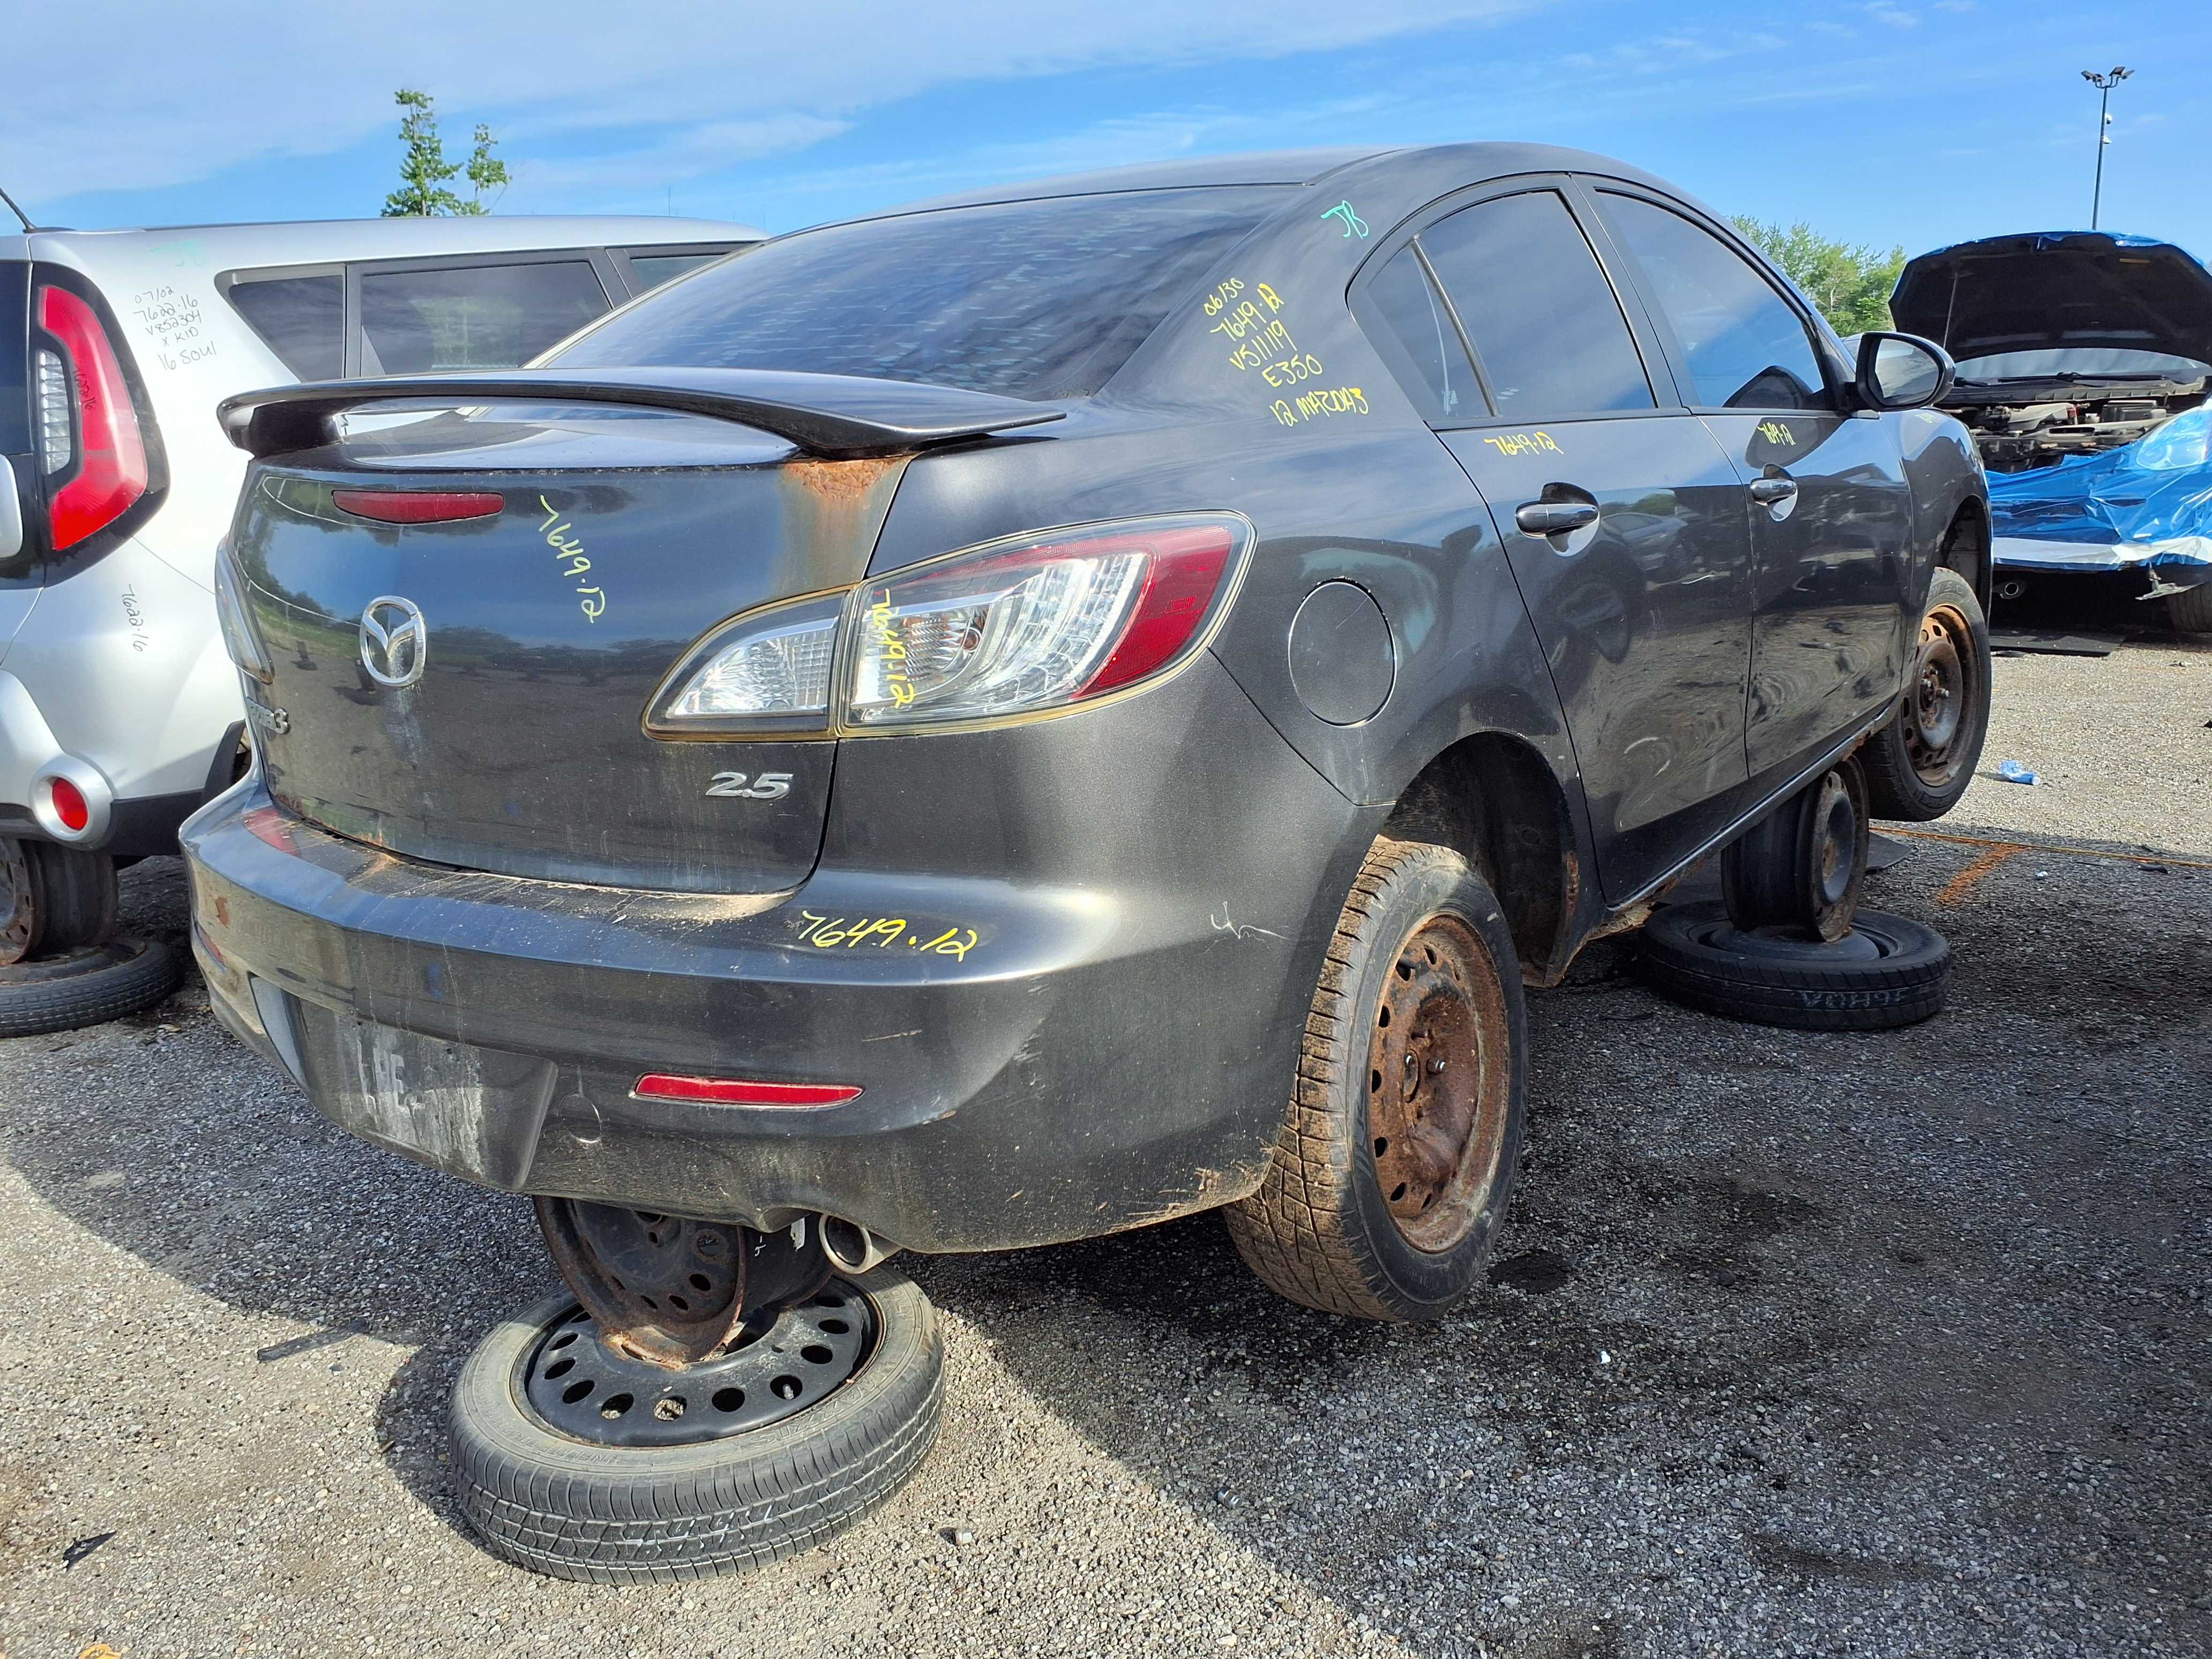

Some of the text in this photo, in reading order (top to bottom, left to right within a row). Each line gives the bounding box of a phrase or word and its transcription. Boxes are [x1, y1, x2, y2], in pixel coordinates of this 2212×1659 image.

[134, 286, 175, 303] 07/02
[1203, 278, 1244, 316] 06/30
[145, 309, 201, 335] V852304
[158, 353, 176, 370] 16
[1261, 354, 1324, 387] E350
[1269, 386, 1369, 427] 12 MAZDA3
[705, 772, 794, 799] 2.5
[750, 1370, 887, 1446] MAXXIS
